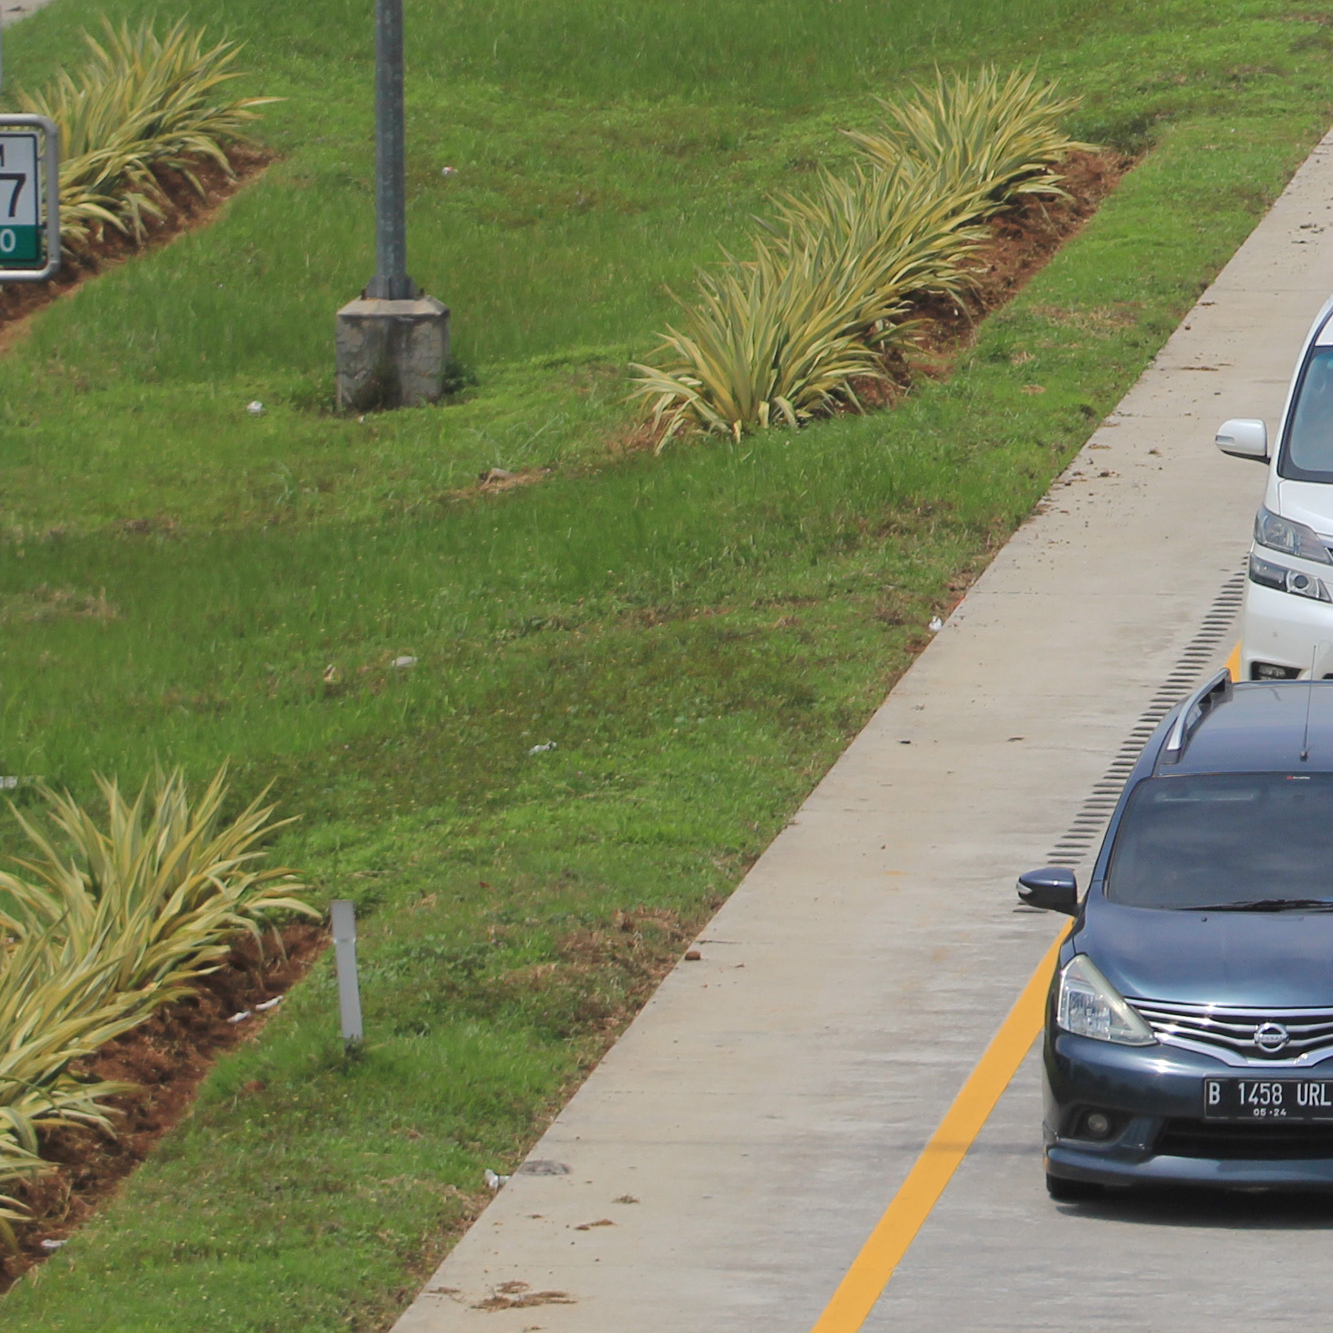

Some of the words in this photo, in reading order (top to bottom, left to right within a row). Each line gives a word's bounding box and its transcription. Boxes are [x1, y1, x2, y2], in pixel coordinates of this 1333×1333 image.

[1209, 1082, 1221, 1105] B
[1239, 1082, 1283, 1105] 1458
[1297, 1083, 1332, 1106] URL
